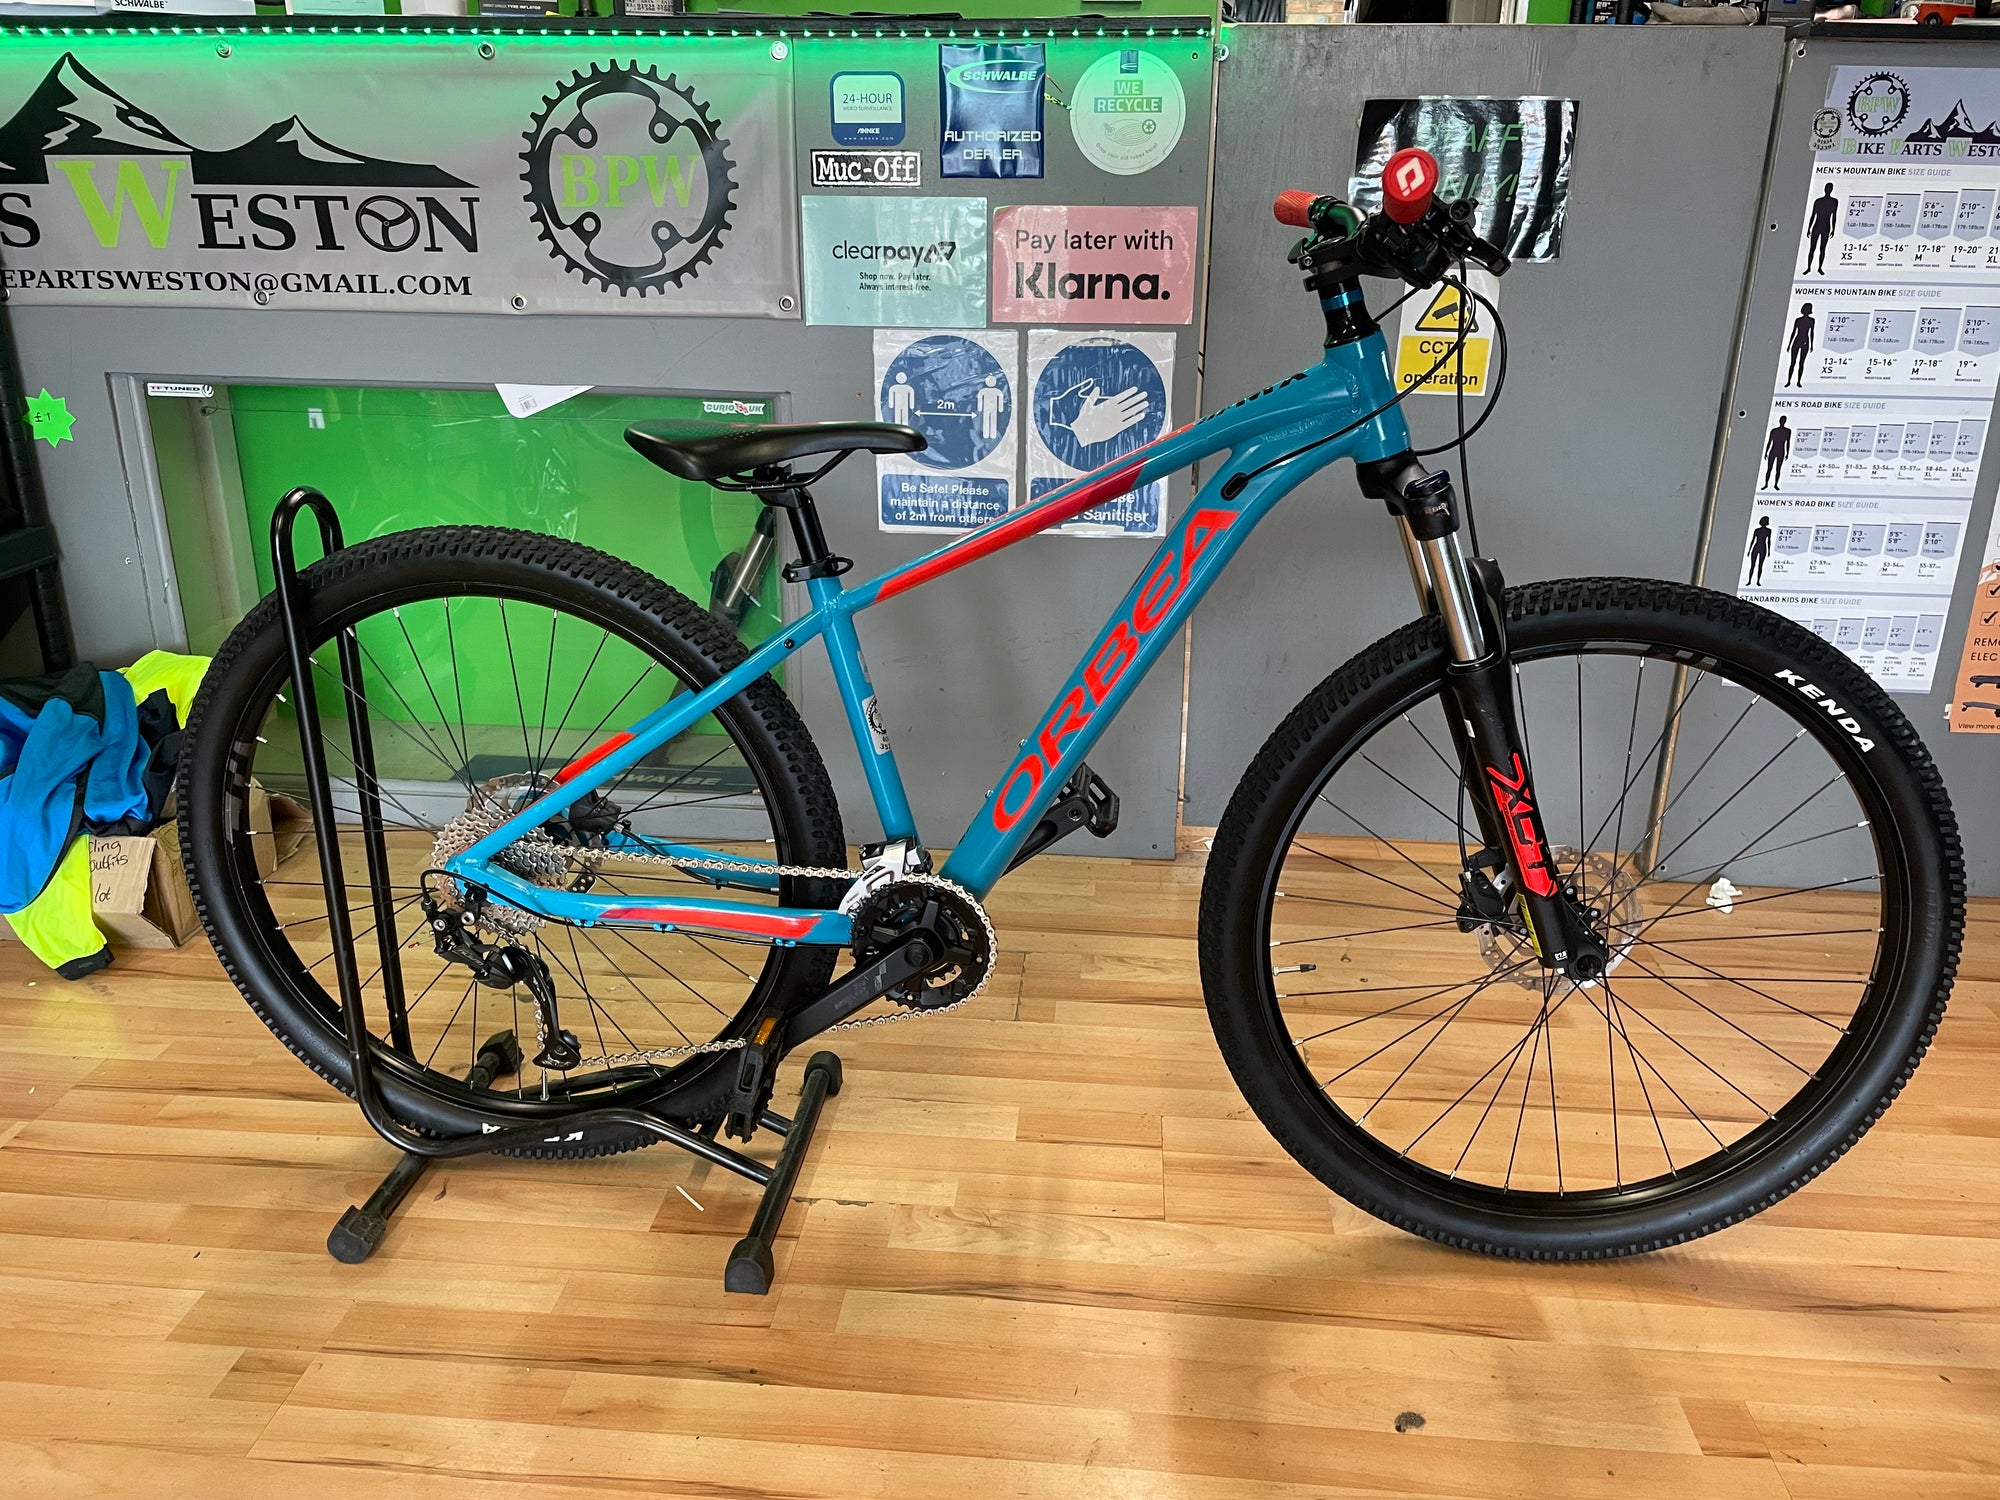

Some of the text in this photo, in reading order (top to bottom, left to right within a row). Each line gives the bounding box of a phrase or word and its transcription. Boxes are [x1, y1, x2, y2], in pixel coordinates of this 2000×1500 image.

[114, 0, 165, 8] SCHWALBE
[962, 70, 1037, 81] SCHWALBE
[1116, 81, 1141, 95] WE
[842, 92, 893, 104] 24-HOUR
[1096, 98, 1160, 112] RECYCLE
[1857, 96, 1900, 112] BPW
[944, 130, 1042, 142] AUTHORIZED
[963, 148, 1023, 160] DEALER
[1842, 138, 1886, 156] BIKE
[1889, 138, 1943, 156] PARTS
[817, 156, 916, 182] Muc-Off
[1816, 166, 1842, 175] MEN'S
[1843, 167, 1886, 176] MOUNTAIN
[1888, 168, 1907, 176] BIKE
[1927, 169, 1952, 177] GUIDE
[558, 154, 700, 208] BPW
[1015, 229, 1174, 254] Pay later with
[832, 240, 924, 268] clearpay
[860, 272, 878, 281] Shop
[898, 273, 911, 282] Pay
[912, 272, 931, 280] later.
[1015, 262, 1171, 300] Klarna.
[859, 282, 883, 292] Always
[1794, 288, 1832, 296] WOMEN'S
[1834, 288, 1876, 296] MOUNTAIN
[1419, 340, 1467, 354] CCT
[937, 400, 955, 410] 2m
[901, 482, 990, 496] Be Safe! Please
[890, 496, 1000, 511] maintain a distance
[895, 511, 907, 520] of
[909, 512, 926, 521] 2m
[929, 512, 956, 522] from
[1083, 509, 1150, 521] Sanitiser
[1970, 652, 2000, 660] ELEC
[991, 508, 1240, 832] ORBEA
[1774, 669, 1875, 753] KENDA
